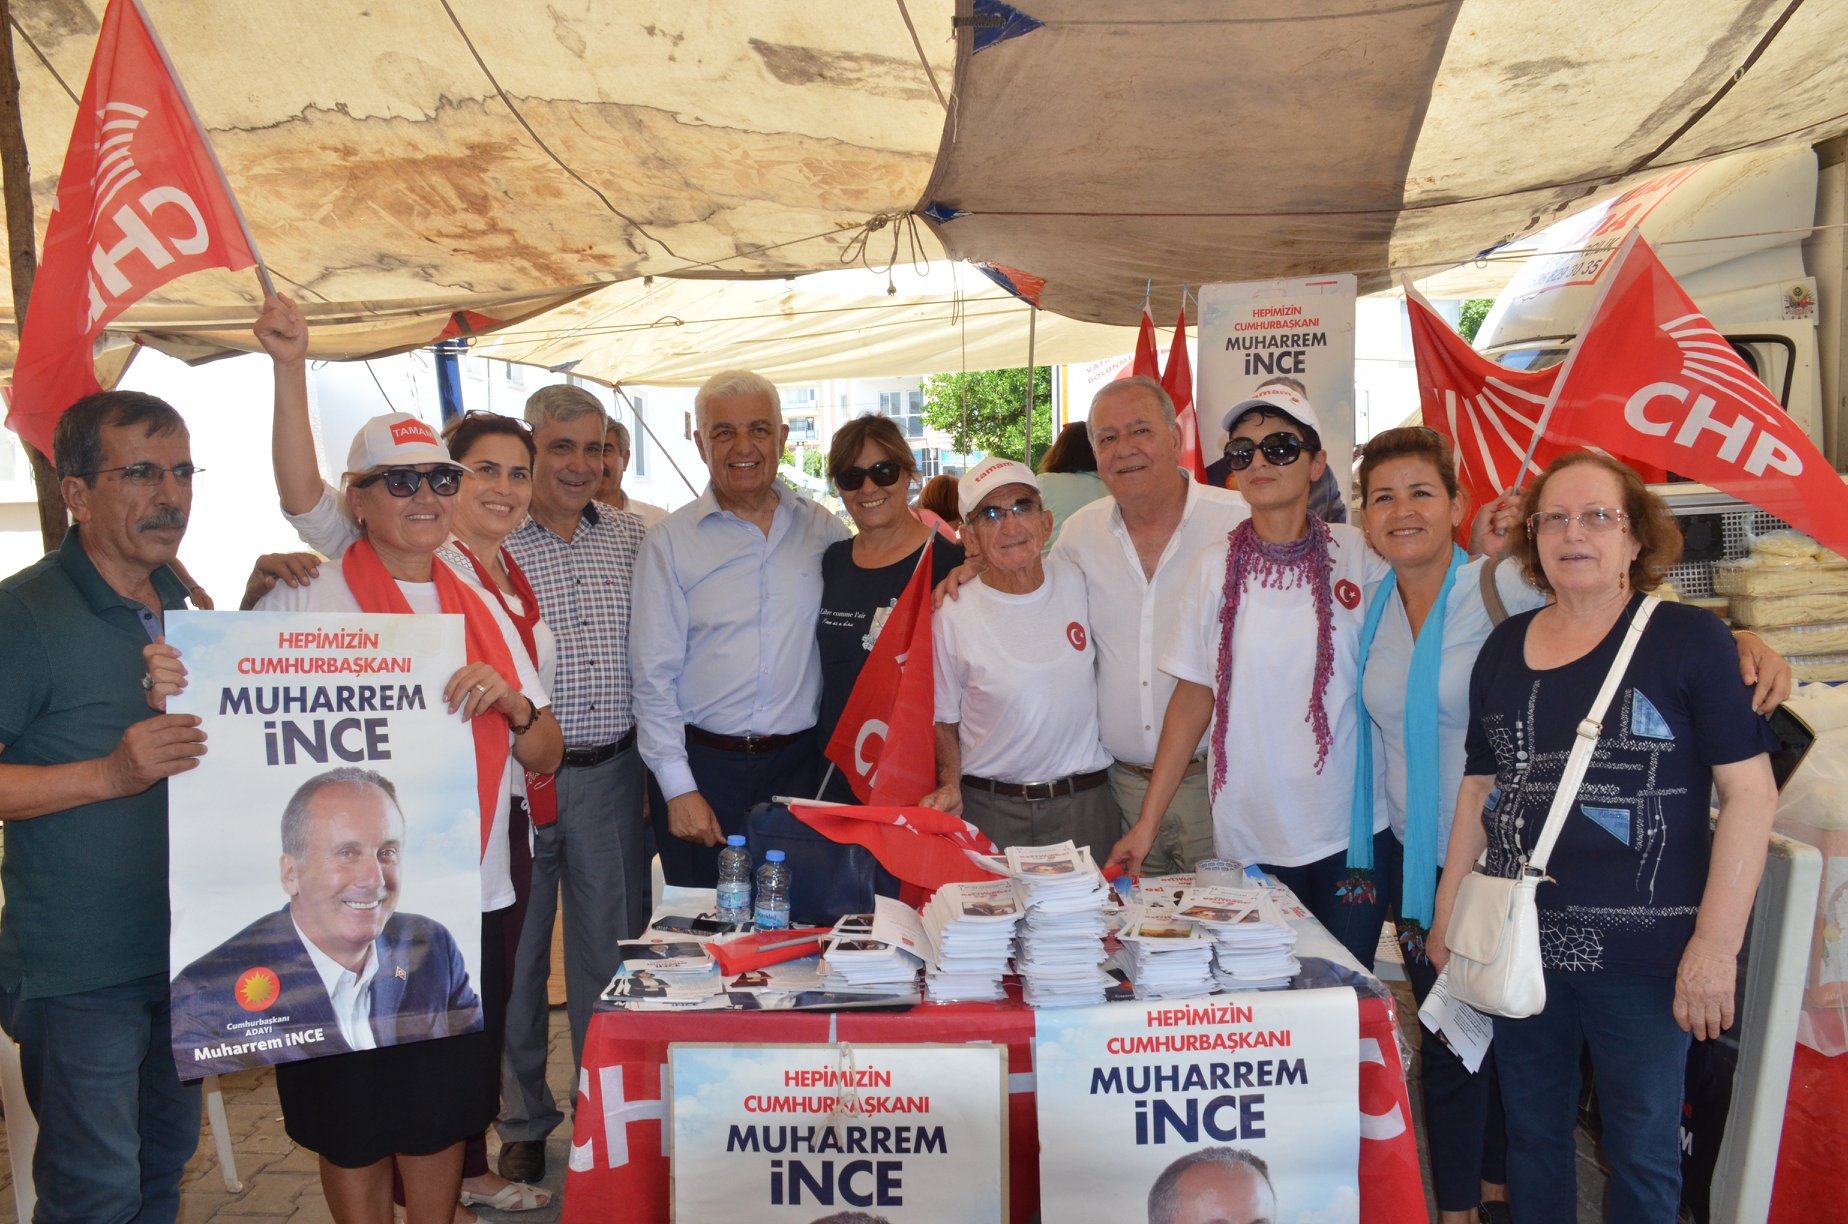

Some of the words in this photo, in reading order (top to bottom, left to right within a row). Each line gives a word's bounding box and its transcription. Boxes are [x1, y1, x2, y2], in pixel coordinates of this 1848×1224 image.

[1581, 259, 1603, 275] 35
[1252, 304, 1302, 318] HEPİMİZİN
[1234, 318, 1320, 332] CUMHURBAŞKANI
[1225, 332, 1327, 351] MUHARREM
[392, 426, 434, 439] TAMAM
[1624, 381, 1804, 478] CHP
[975, 461, 1014, 483] tamam
[278, 627, 379, 649] HEPİMİZİN
[237, 657, 411, 677] CUMHURBAŞKANI
[219, 684, 426, 715] MUHARREM
[226, 1015, 290, 1031] Cumhurbaşkanı
[1147, 1002, 1253, 1028] HEPİMİZİN
[245, 1027, 273, 1037] ADAYI
[1106, 1030, 1292, 1055] CUMHURBAŞKANI
[194, 1037, 283, 1062] Muharrem
[784, 1064, 891, 1088] HEPİMİZİN
[1089, 1058, 1309, 1095] MUHARREM
[726, 1125, 948, 1154] MUHARREM
